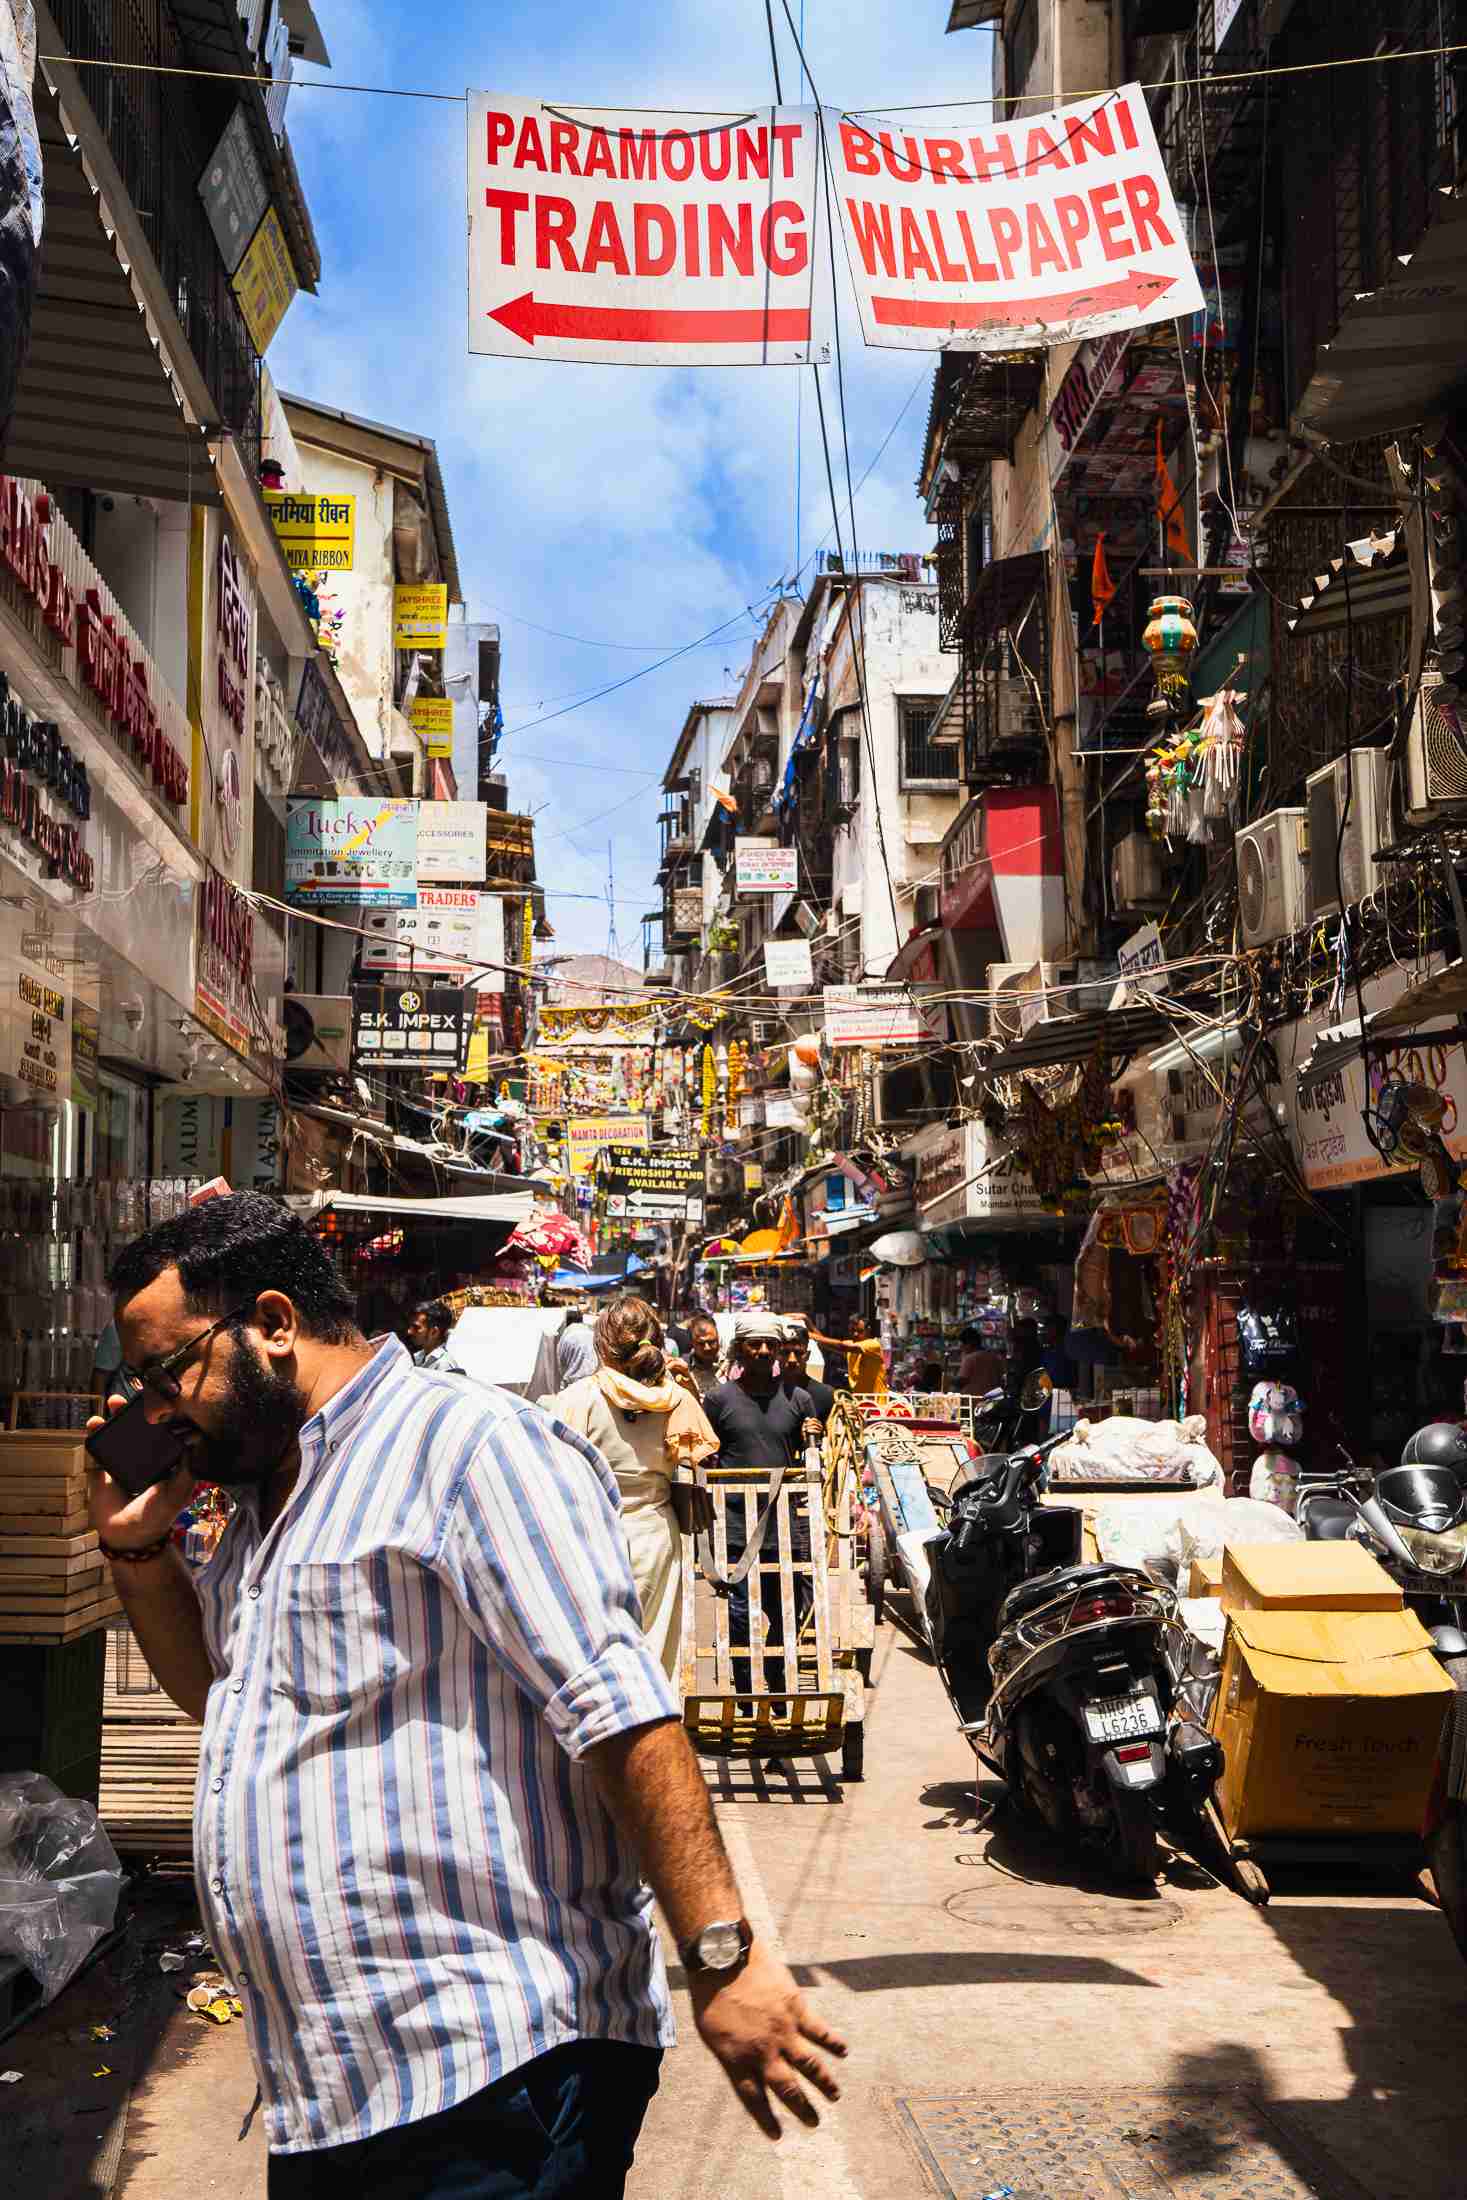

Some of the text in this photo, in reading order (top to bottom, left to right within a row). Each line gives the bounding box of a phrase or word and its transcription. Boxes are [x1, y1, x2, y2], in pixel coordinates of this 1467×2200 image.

[487, 111, 802, 182] PARAMOUNT
[839, 101, 1139, 185] BURHANI
[485, 188, 808, 277] TRADING
[845, 174, 1177, 282] WALLPAPER
[311, 549, 349, 566] RIBBON
[299, 810, 377, 846] Lucky
[419, 892, 476, 906] TRADERS
[360, 1013, 456, 1029] S.K. IMPEX
[626, 1179, 687, 1190] AVAILABLE
[976, 1183, 1009, 1195] Sutar
[1294, 1734, 1353, 1753] Fresh
